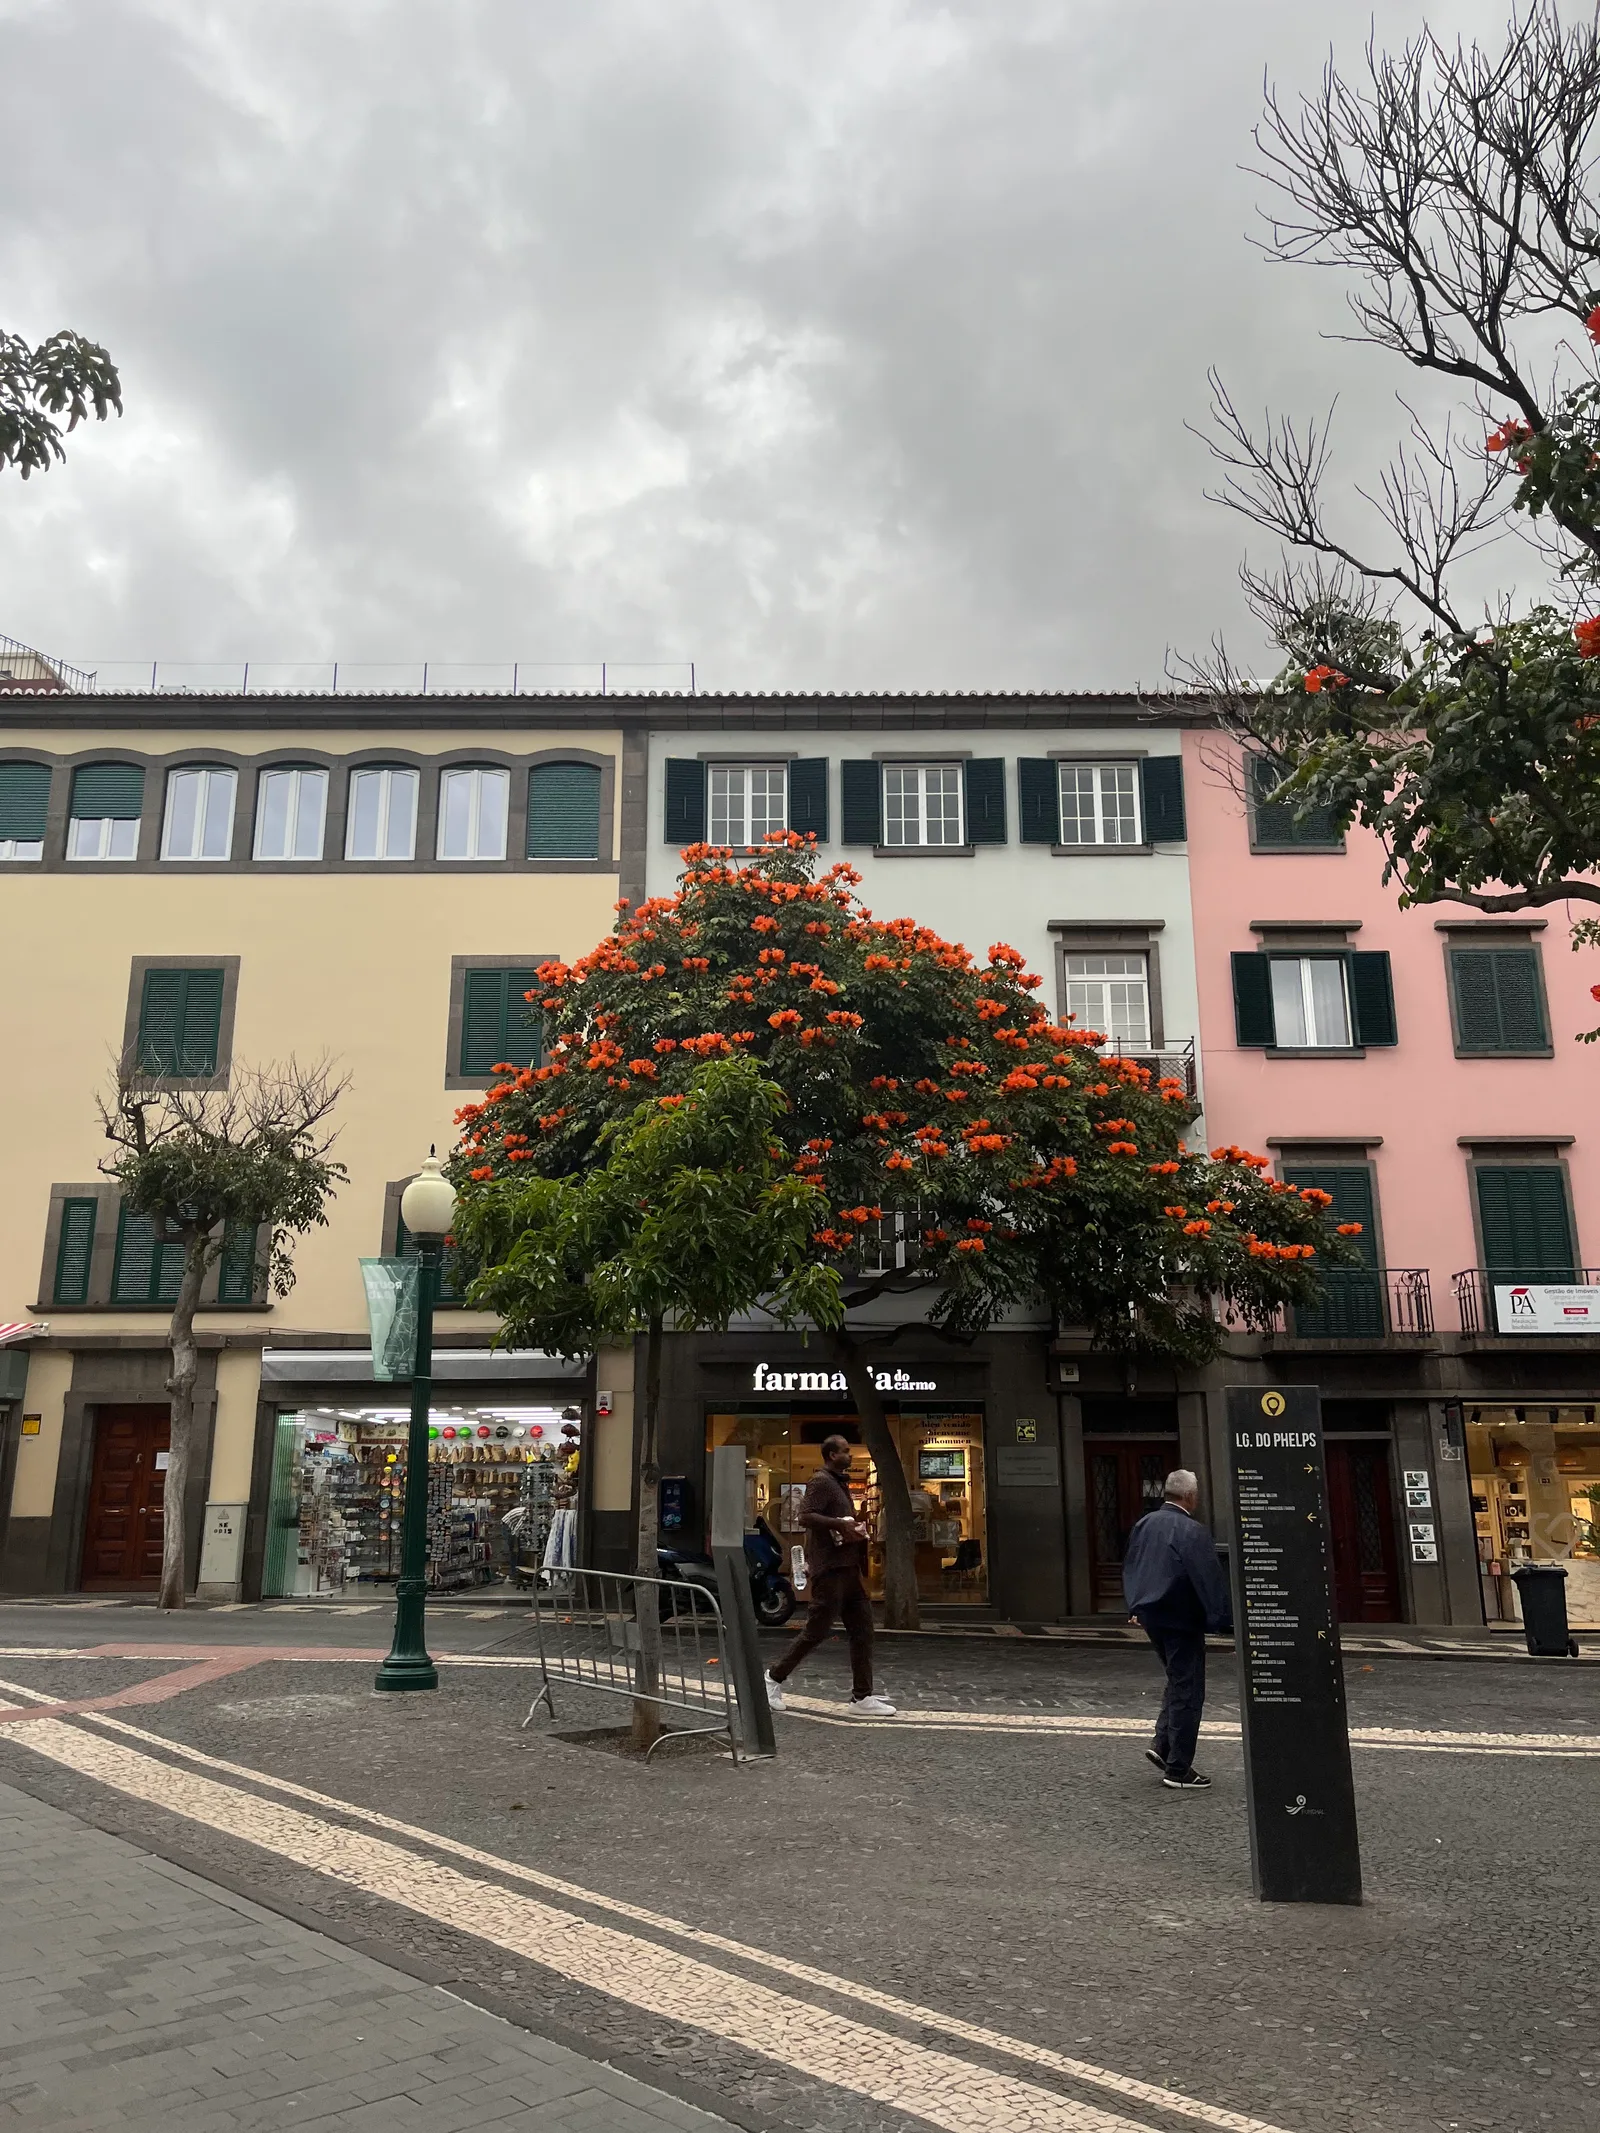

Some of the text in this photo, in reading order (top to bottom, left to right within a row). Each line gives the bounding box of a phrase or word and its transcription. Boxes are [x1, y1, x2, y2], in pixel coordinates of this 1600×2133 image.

[1509, 1295, 1536, 1314] PA
[894, 1369, 910, 1381] do
[894, 1381, 936, 1391] carmo
[1236, 1433, 1317, 1447] LG. DO PHELPS
